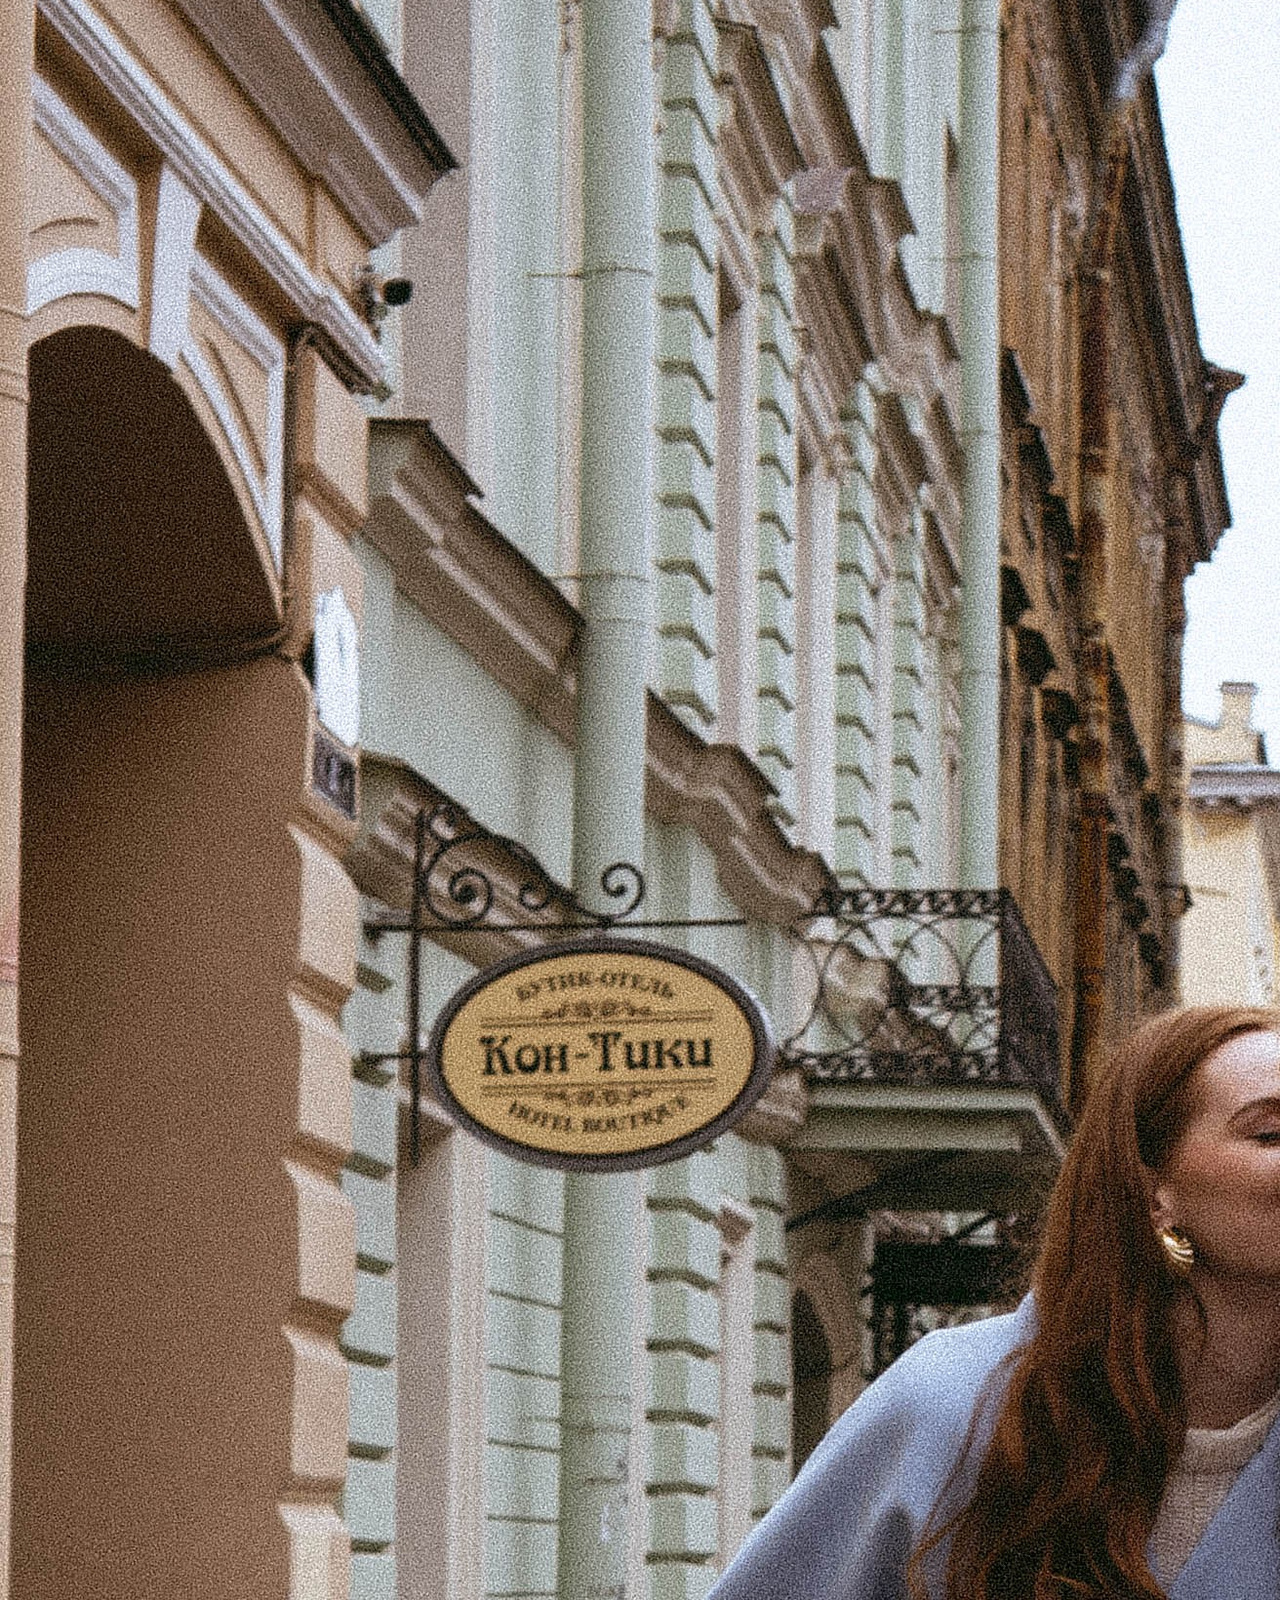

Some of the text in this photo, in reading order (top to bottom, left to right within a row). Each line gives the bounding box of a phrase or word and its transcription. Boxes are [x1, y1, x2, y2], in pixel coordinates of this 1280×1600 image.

[516, 971, 673, 1001] БУТИК-ОТЕЛЬ
[478, 1031, 713, 1076] Кон-Тики
[508, 1100, 573, 1133] HOTEL
